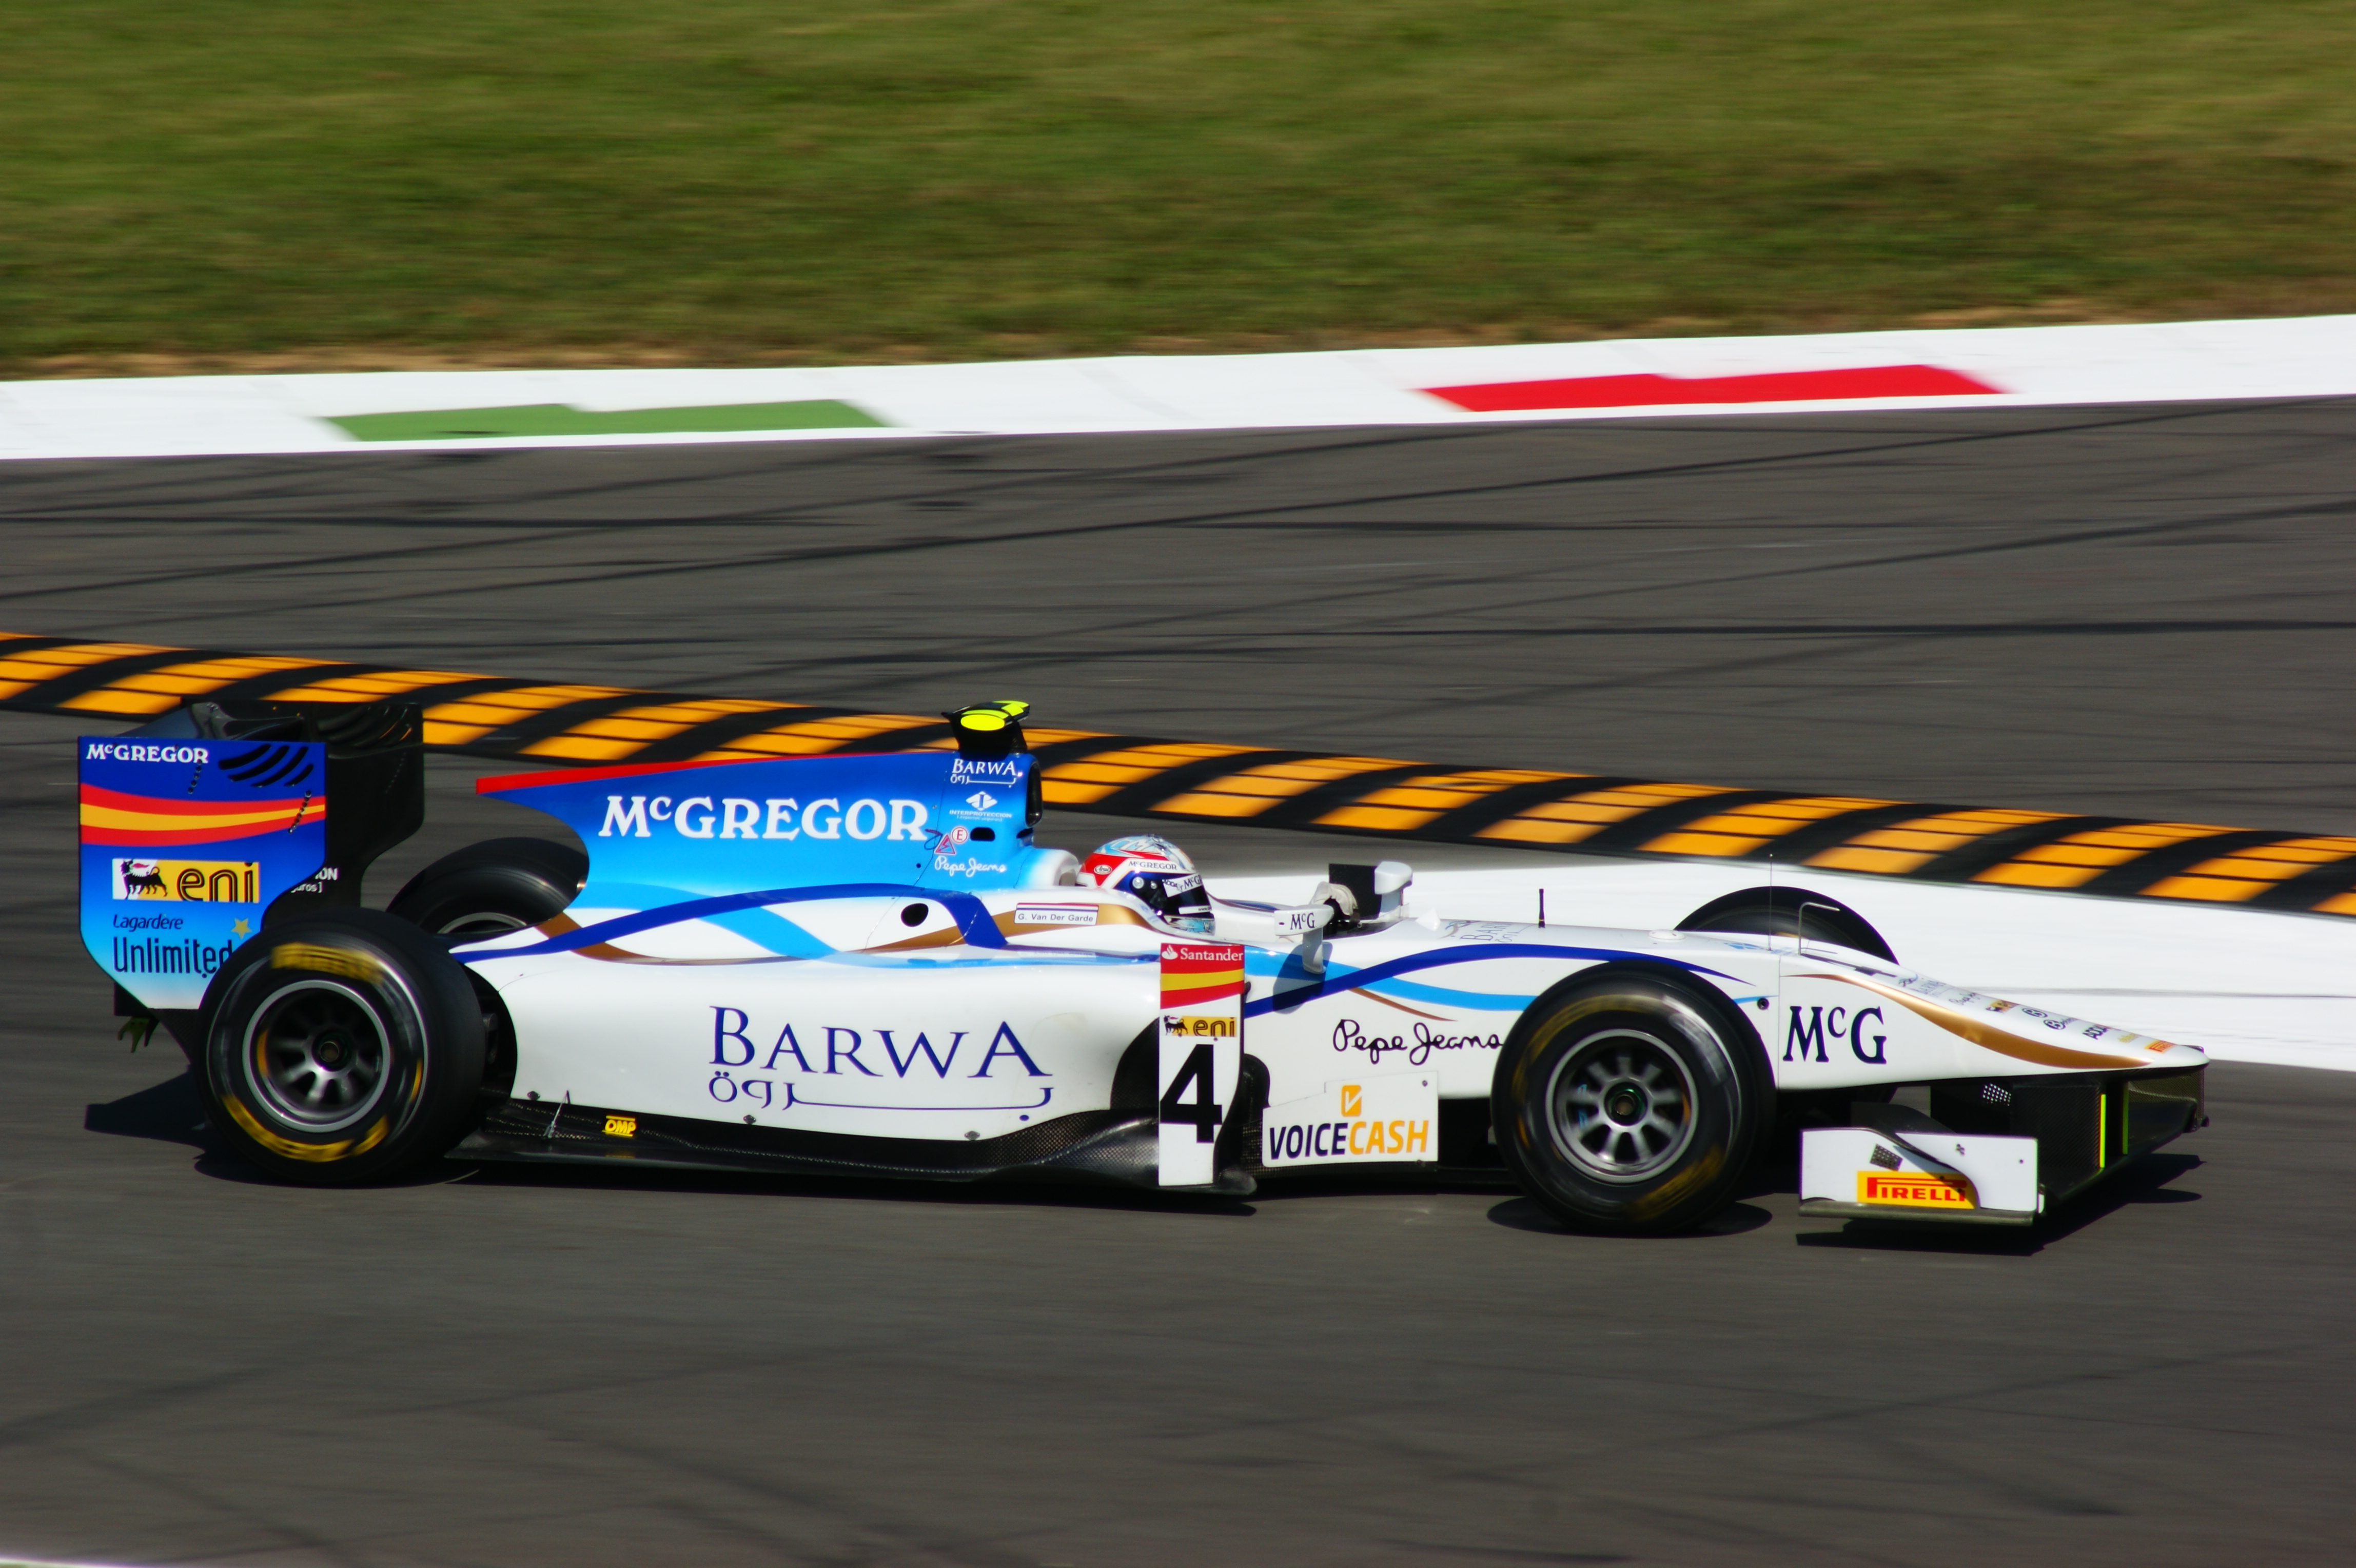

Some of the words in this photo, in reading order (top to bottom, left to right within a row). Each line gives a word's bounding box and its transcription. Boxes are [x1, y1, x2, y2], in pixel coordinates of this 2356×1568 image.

[86, 743, 208, 763] McGREGOR
[952, 758, 1017, 776] BARWA
[598, 796, 927, 841] McGREGOR
[949, 810, 1012, 818] INTERPROTECCION
[956, 829, 964, 840] E
[934, 855, 966, 876] Pepe
[966, 857, 1007, 877] Jeans
[1128, 860, 1177, 870] McGREGOR
[176, 861, 254, 903] eni
[1290, 912, 1315, 930] McG
[1180, 948, 1243, 961] Santander
[1193, 1017, 1235, 1037] eni
[1782, 1006, 1887, 1064] McG
[709, 1005, 1053, 1079] BARWA
[1333, 1019, 1408, 1065] Pepe
[1409, 1022, 1505, 1066] Jeans
[1160, 1044, 1223, 1144] 4
[604, 1119, 636, 1134] OMP
[1269, 1120, 1429, 1160] VOICECASH
[1867, 1177, 1967, 1202] PIRELLI
